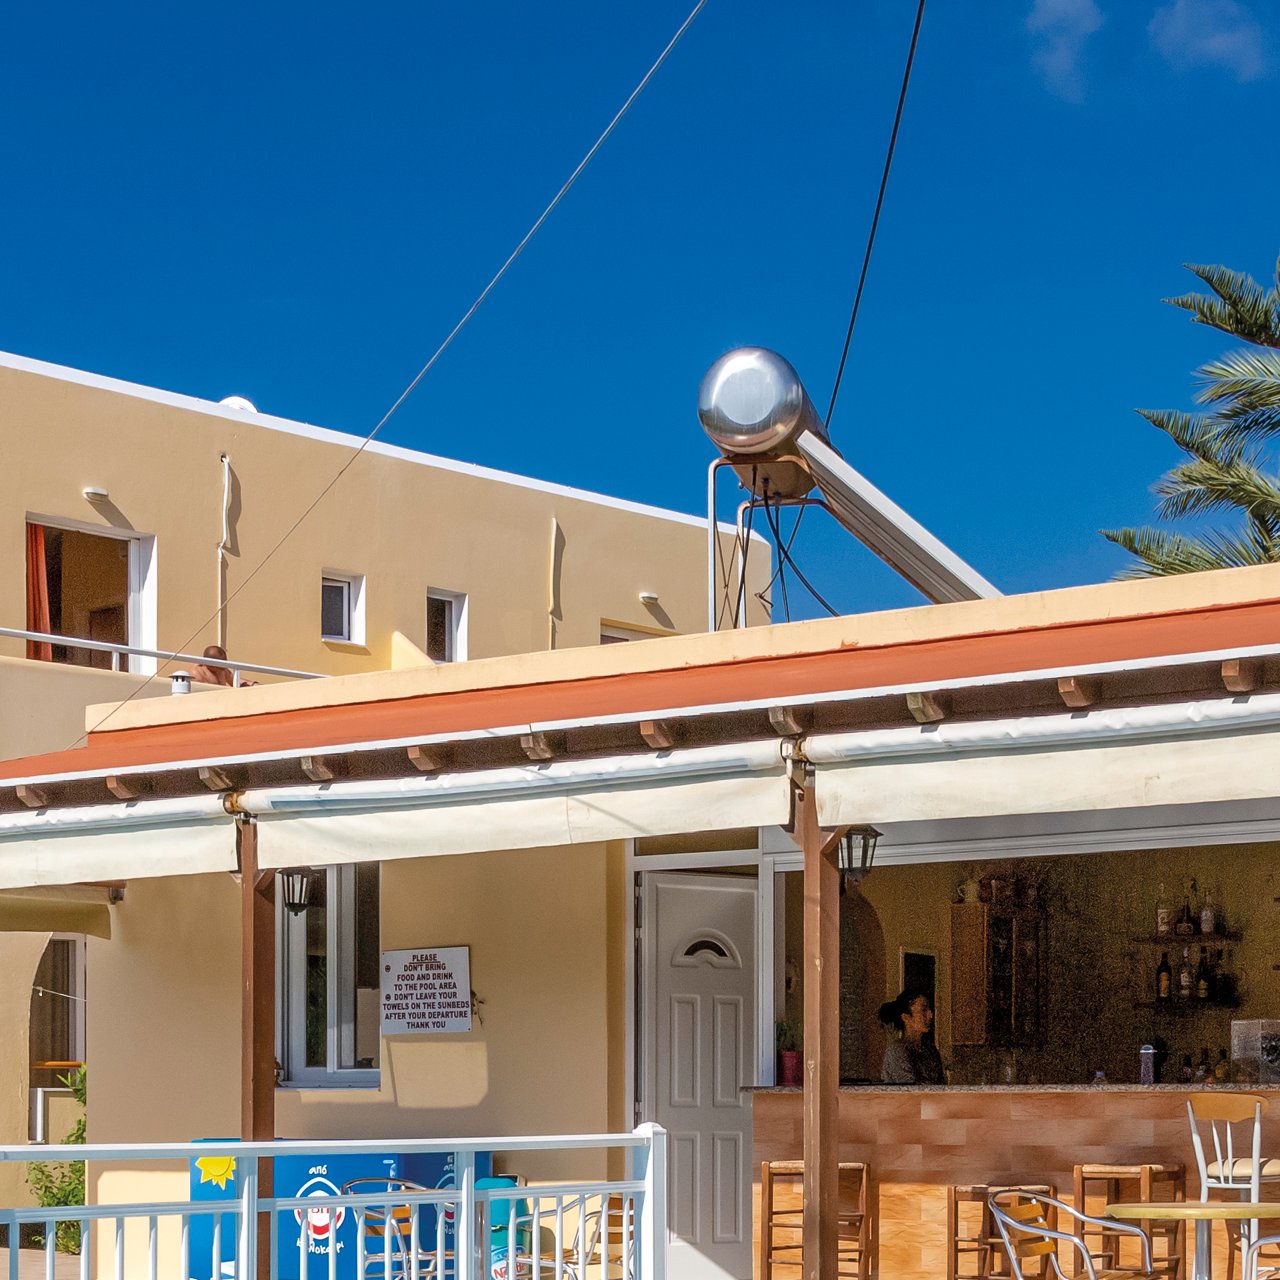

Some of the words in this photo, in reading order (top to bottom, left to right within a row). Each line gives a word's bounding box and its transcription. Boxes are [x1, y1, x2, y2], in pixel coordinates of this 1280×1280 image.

[412, 953, 437, 962] PLEASE
[404, 964, 423, 972] DON'T
[425, 963, 446, 971] BRING
[397, 974, 415, 982] FOOD
[417, 973, 430, 981] AND
[432, 972, 453, 980] DRINK
[394, 984, 402, 992] TO
[405, 983, 418, 991] THE
[420, 982, 437, 990] POOL
[439, 982, 457, 990] AREA
[394, 993, 414, 1001] DON'T
[416, 992, 437, 1000] LEAVE
[439, 991, 457, 1000] YOUR
[383, 1003, 409, 1011] TOWELS
[411, 1002, 420, 1010] ON
[423, 1002, 436, 1010] THE
[438, 1000, 470, 1009] SUNBEDS
[385, 1012, 406, 1020] AFTER
[408, 1011, 426, 1019] YOUR
[428, 1010, 468, 1018] DEPARTURE
[407, 1021, 430, 1029] THANK
[432, 1020, 446, 1029] YOU
